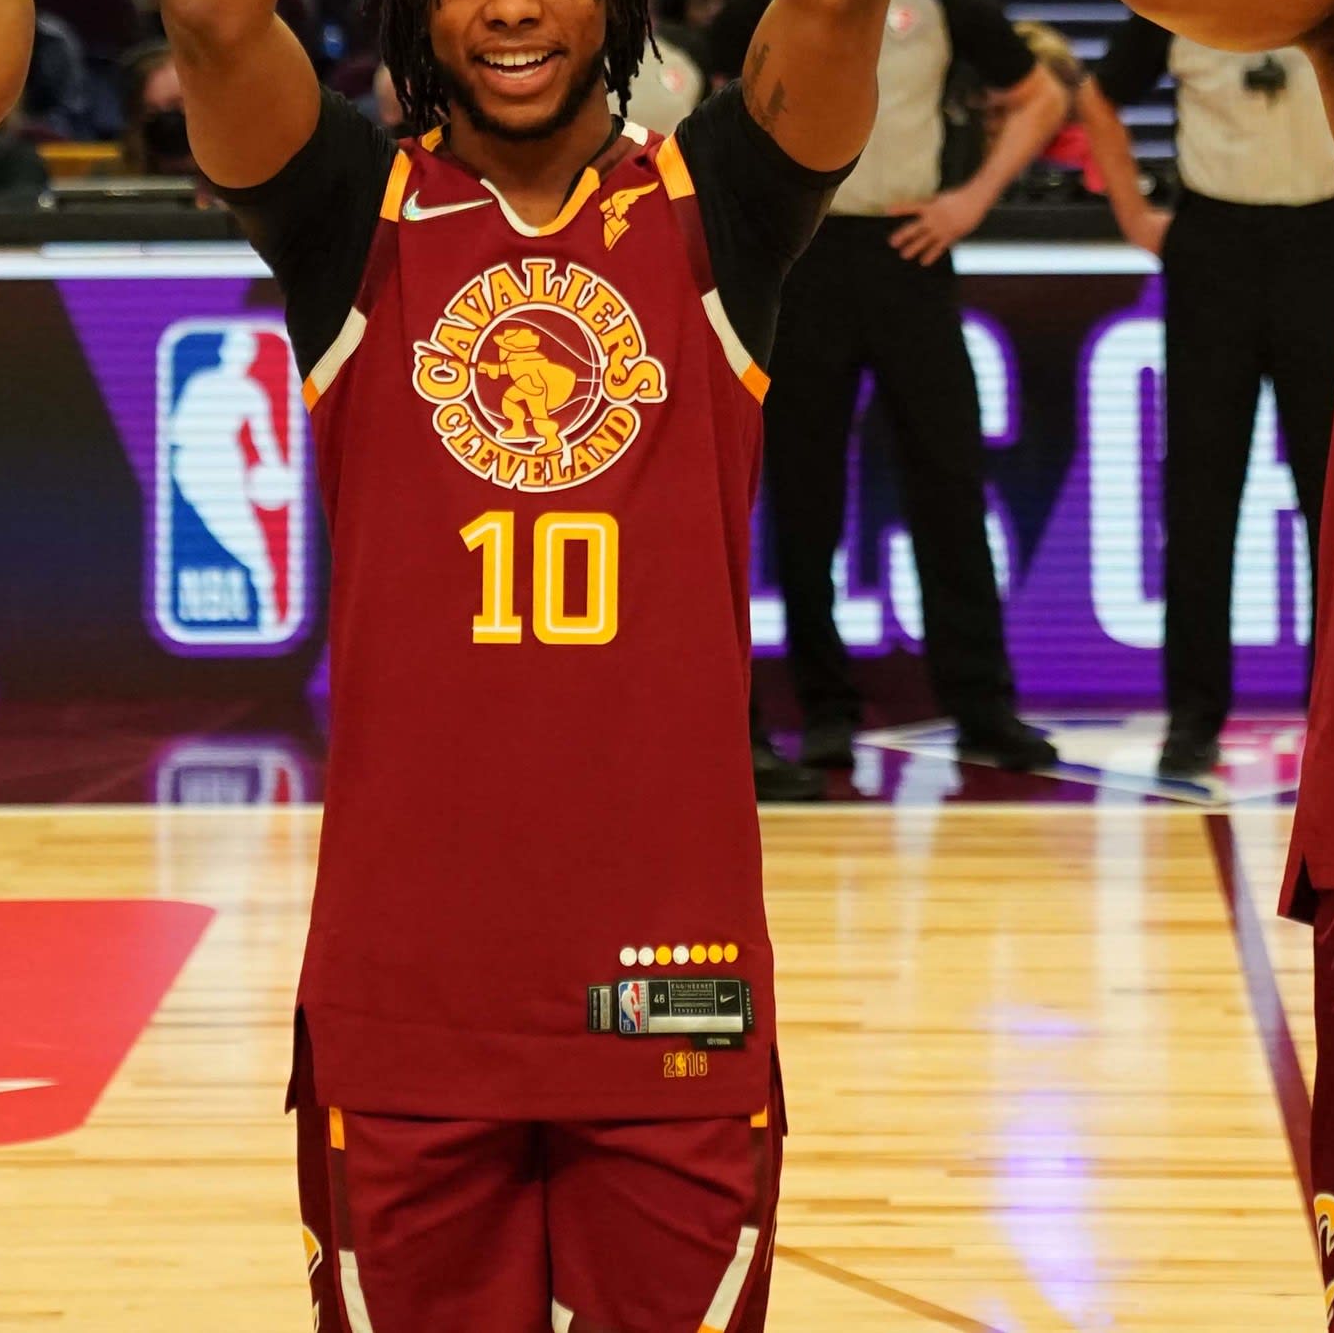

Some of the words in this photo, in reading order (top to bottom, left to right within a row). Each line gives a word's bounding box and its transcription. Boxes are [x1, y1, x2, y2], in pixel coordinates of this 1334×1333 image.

[413, 258, 667, 405] CAVALIERS
[432, 399, 641, 493] CLEVELAND
[459, 511, 619, 646] 10
